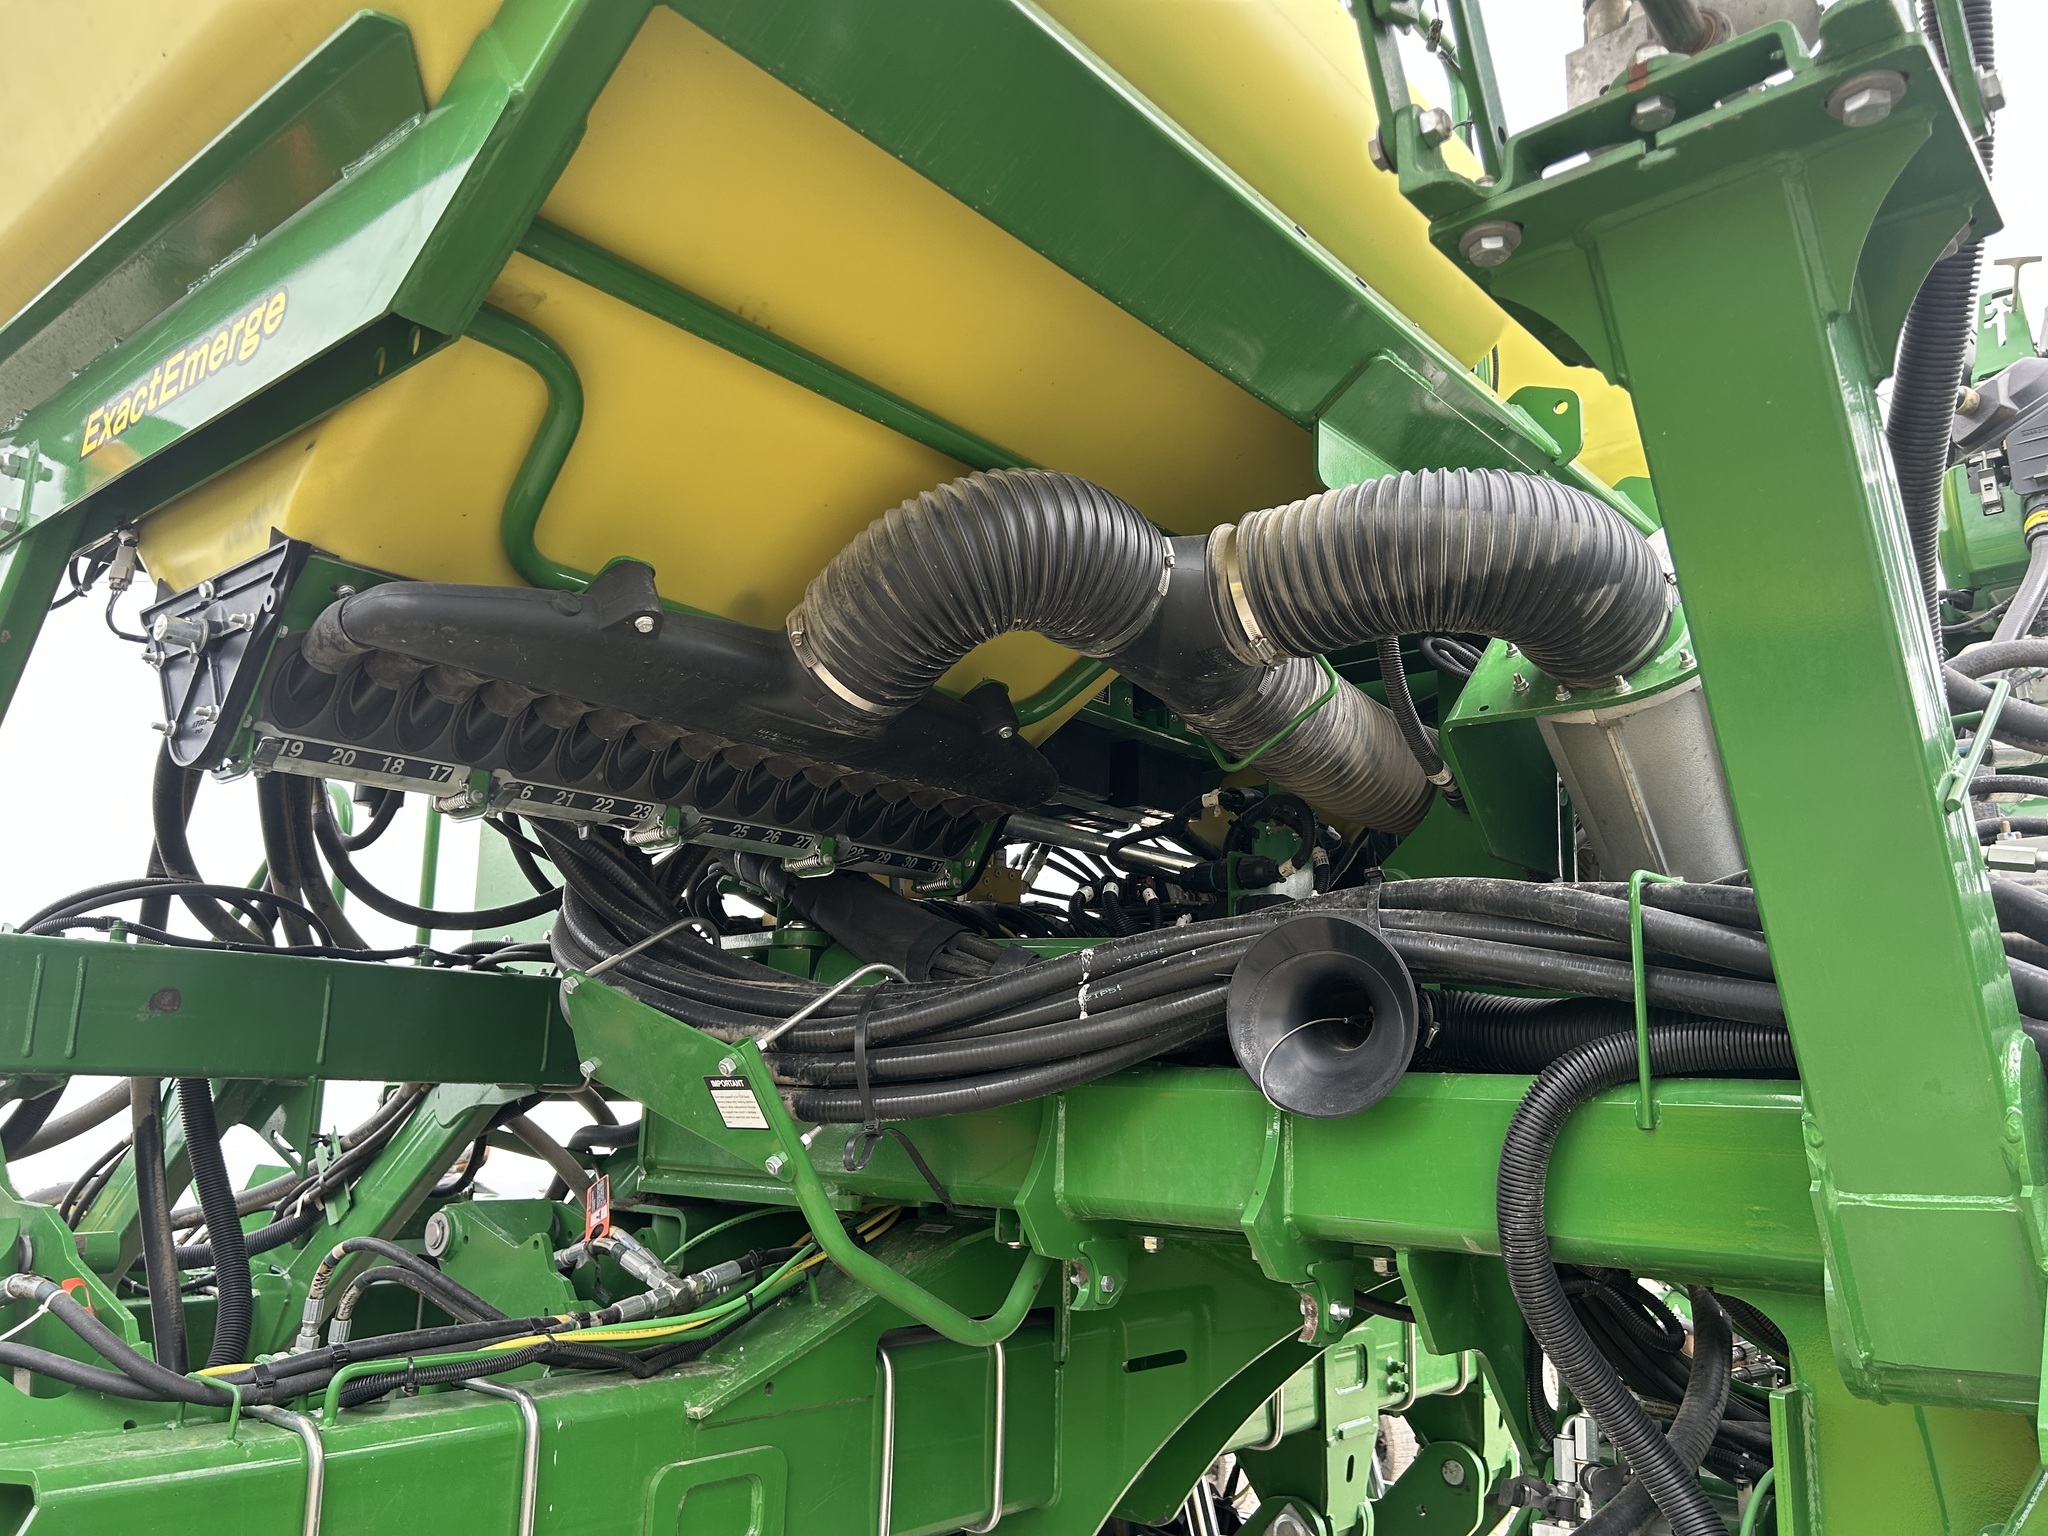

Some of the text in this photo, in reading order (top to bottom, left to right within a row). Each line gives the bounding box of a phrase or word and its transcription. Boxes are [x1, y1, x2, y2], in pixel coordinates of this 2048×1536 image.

[80, 288, 287, 459] ExactEmerge
[279, 739, 453, 781] 19 20 18 17
[552, 791, 576, 807] 21
[592, 797, 615, 813] 22
[631, 804, 652, 819] 23
[729, 824, 813, 849] 25 26 27
[874, 851, 892, 864] 29
[901, 856, 918, 869] 30
[928, 861, 944, 873] 31
[710, 1079, 745, 1088] IMPORTANT
